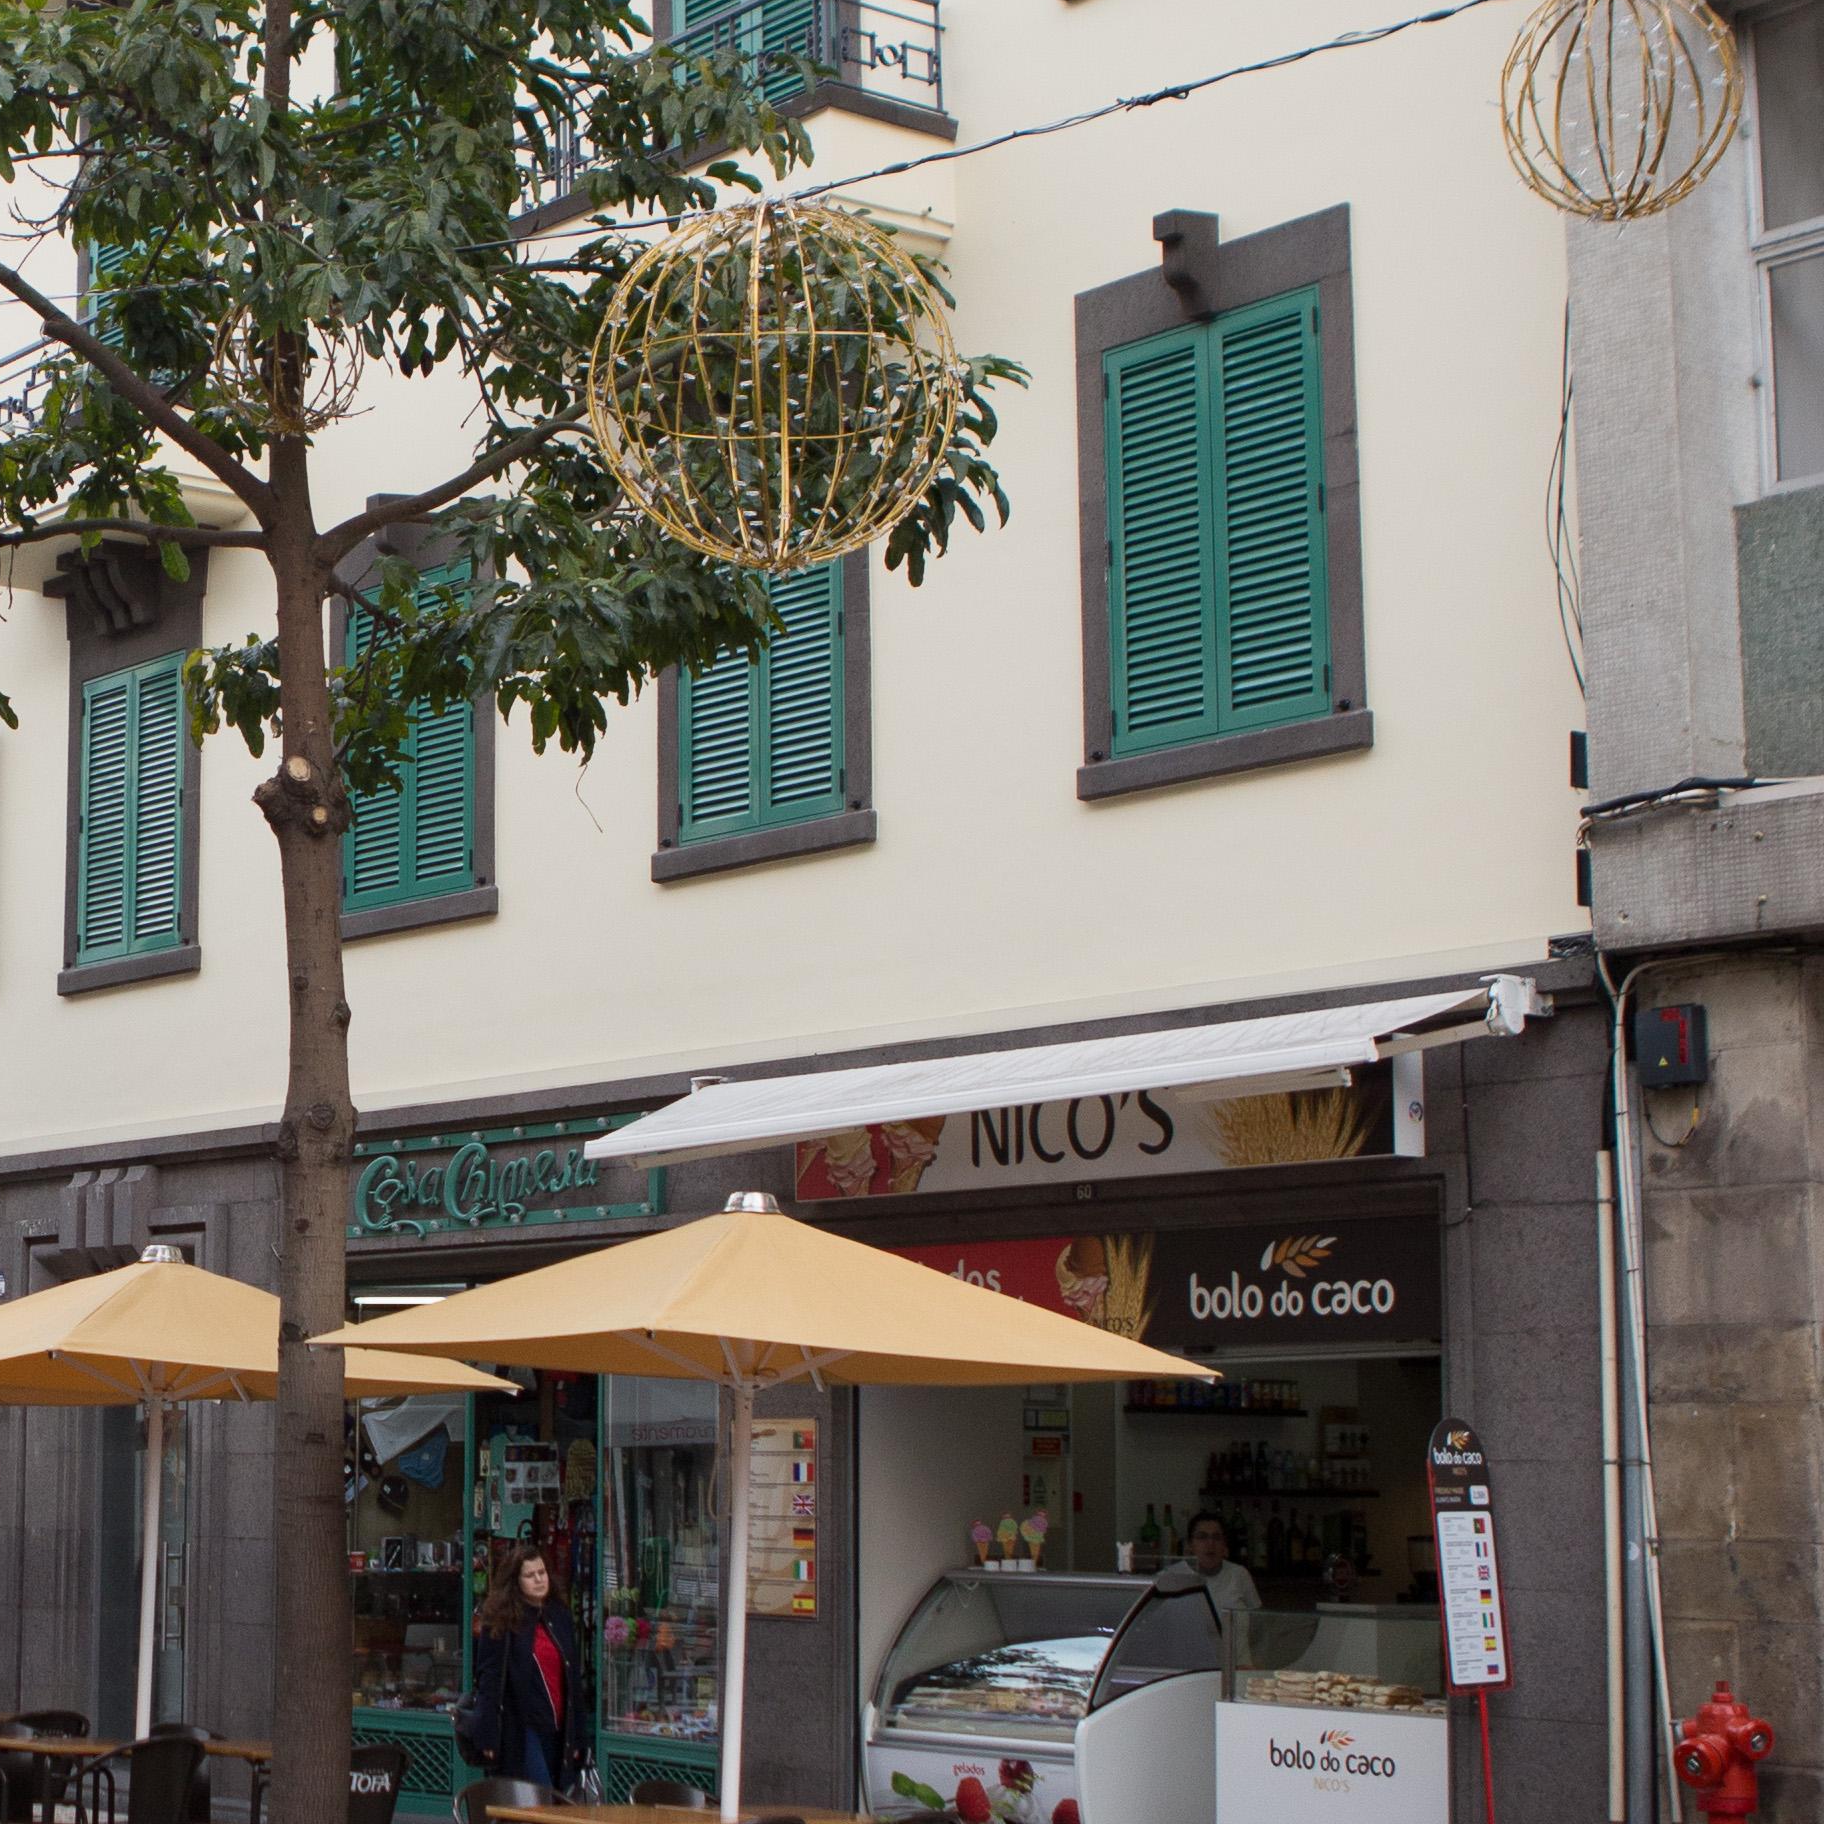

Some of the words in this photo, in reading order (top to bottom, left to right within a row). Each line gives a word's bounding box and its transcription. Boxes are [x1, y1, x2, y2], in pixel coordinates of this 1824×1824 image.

[971, 1089, 1174, 1168] NICO'S
[1076, 1184, 1092, 1200] 60
[1190, 1270, 1264, 1320] bolo
[1269, 1279, 1304, 1317] do
[1311, 1278, 1395, 1316] caco
[1269, 1737, 1316, 1770] bolo
[1320, 1750, 1340, 1773] do
[1345, 1754, 1396, 1778] caco
[349, 1771, 391, 1794] TOFA
[1314, 1776, 1351, 1793] NICO'S
